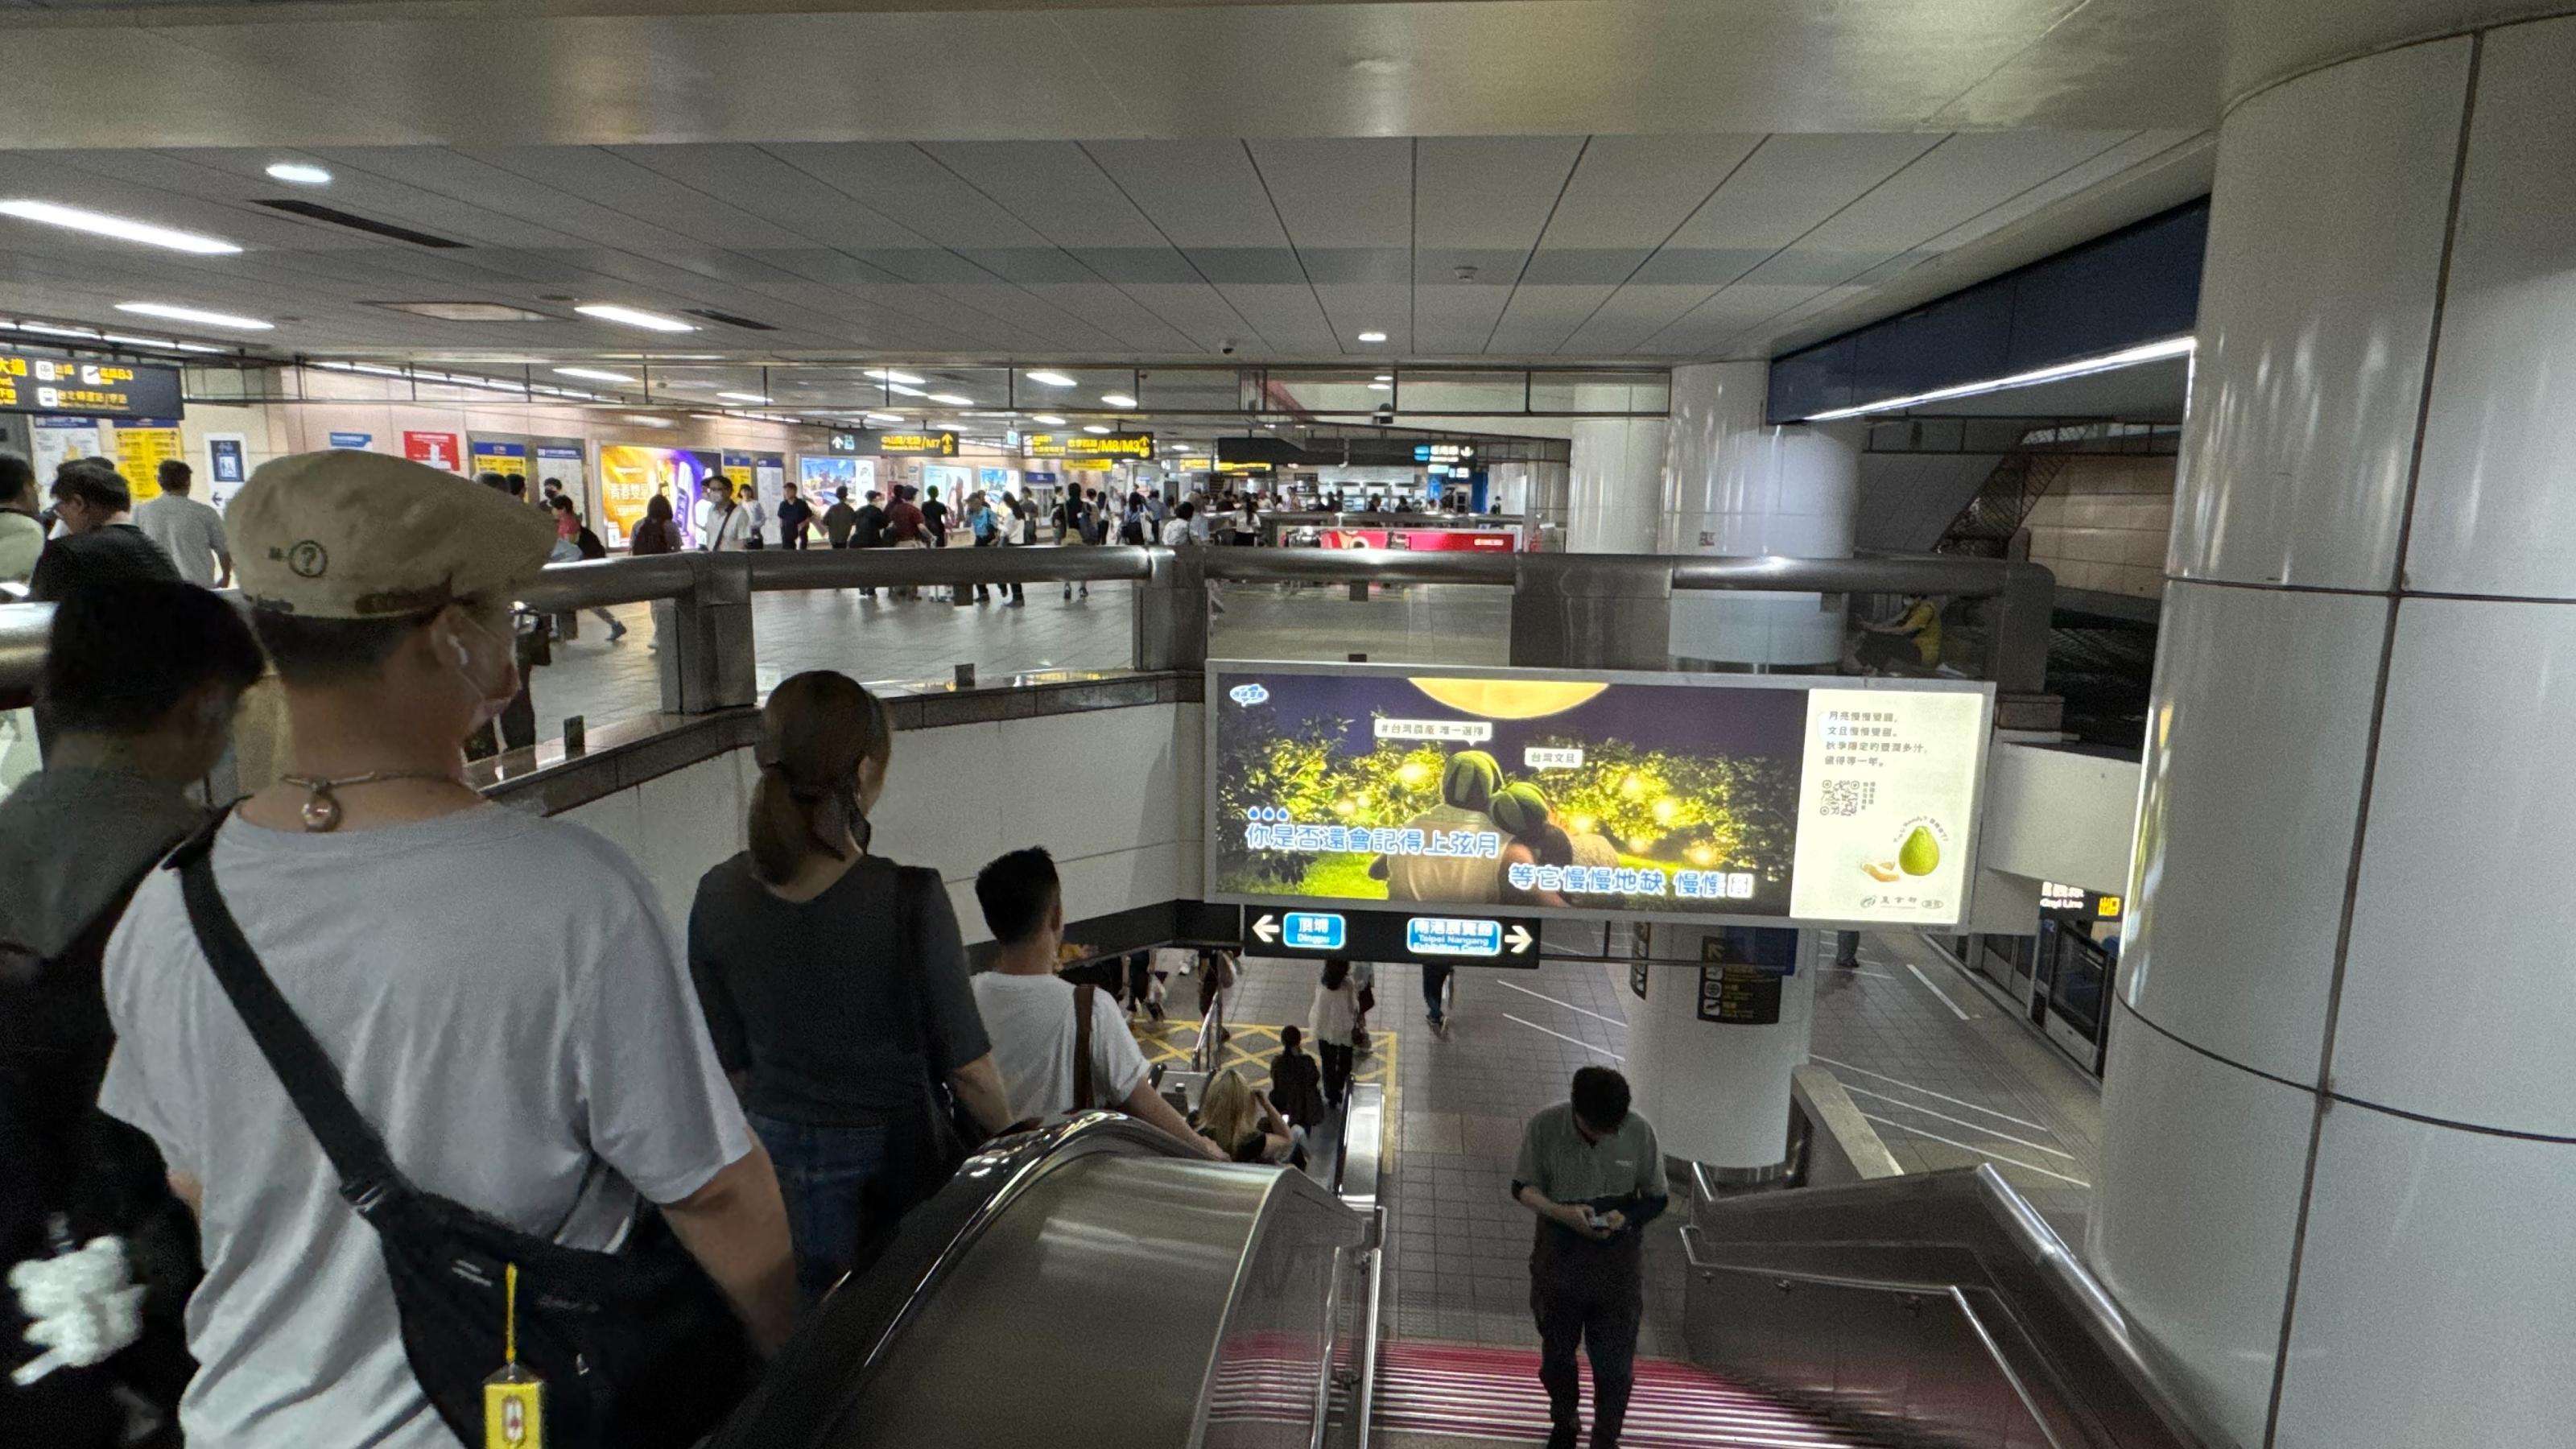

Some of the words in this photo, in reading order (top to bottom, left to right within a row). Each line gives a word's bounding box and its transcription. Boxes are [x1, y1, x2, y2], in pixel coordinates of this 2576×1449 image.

[1531, 751, 1576, 764] 台灣文旦
[1245, 824, 1500, 857] 你是否還會記得上弦月
[1509, 863, 1666, 894] 等它慢慢地缺
[2099, 897, 2120, 916] 出口
[1298, 916, 1329, 933] 頂埔
[1414, 919, 1494, 936] 南港展覽館
[1297, 933, 1331, 945] Dingpu
[1418, 935, 1446, 944] Taipei
[1447, 935, 1489, 947] Nangang
